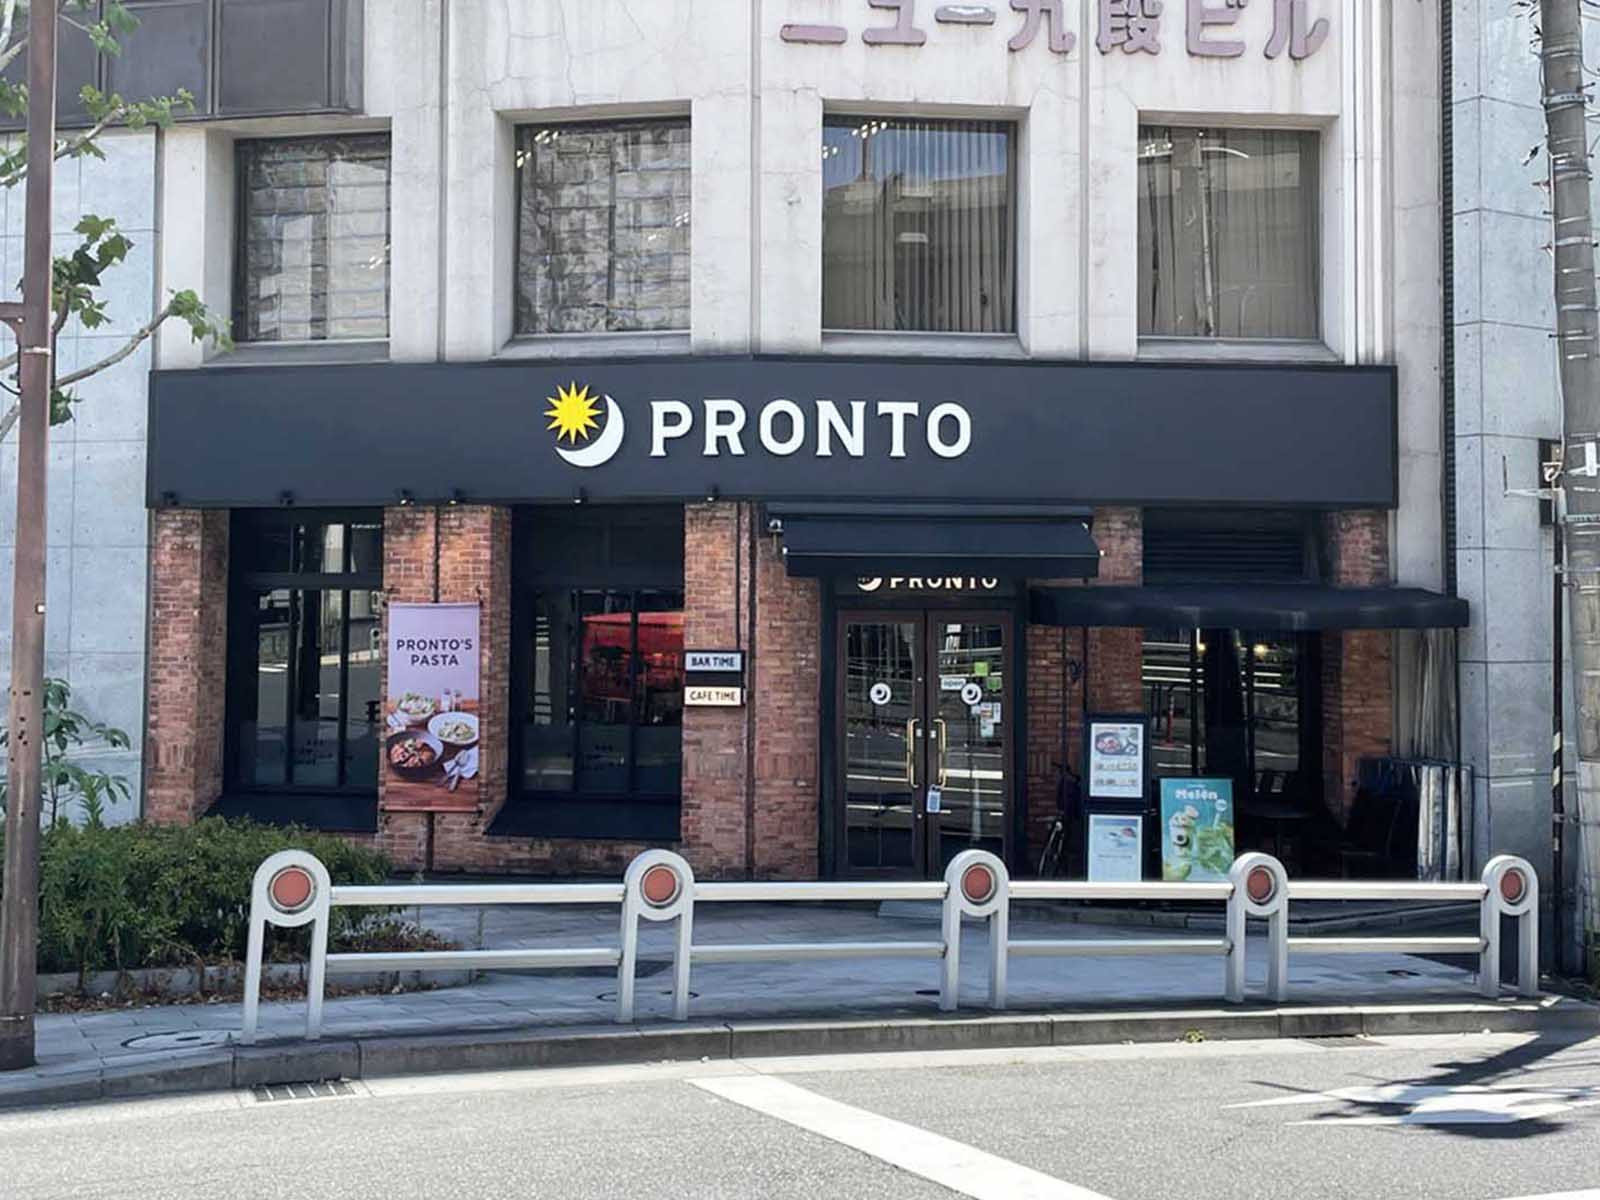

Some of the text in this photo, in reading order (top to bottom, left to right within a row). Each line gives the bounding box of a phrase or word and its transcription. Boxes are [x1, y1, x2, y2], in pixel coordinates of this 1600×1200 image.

[649, 399, 972, 458] PRONTO
[396, 638, 473, 651] PRONTO'S
[410, 654, 460, 667] PASTA
[691, 656, 736, 667] BAR TIME
[690, 691, 736, 701] CAFE TIME
